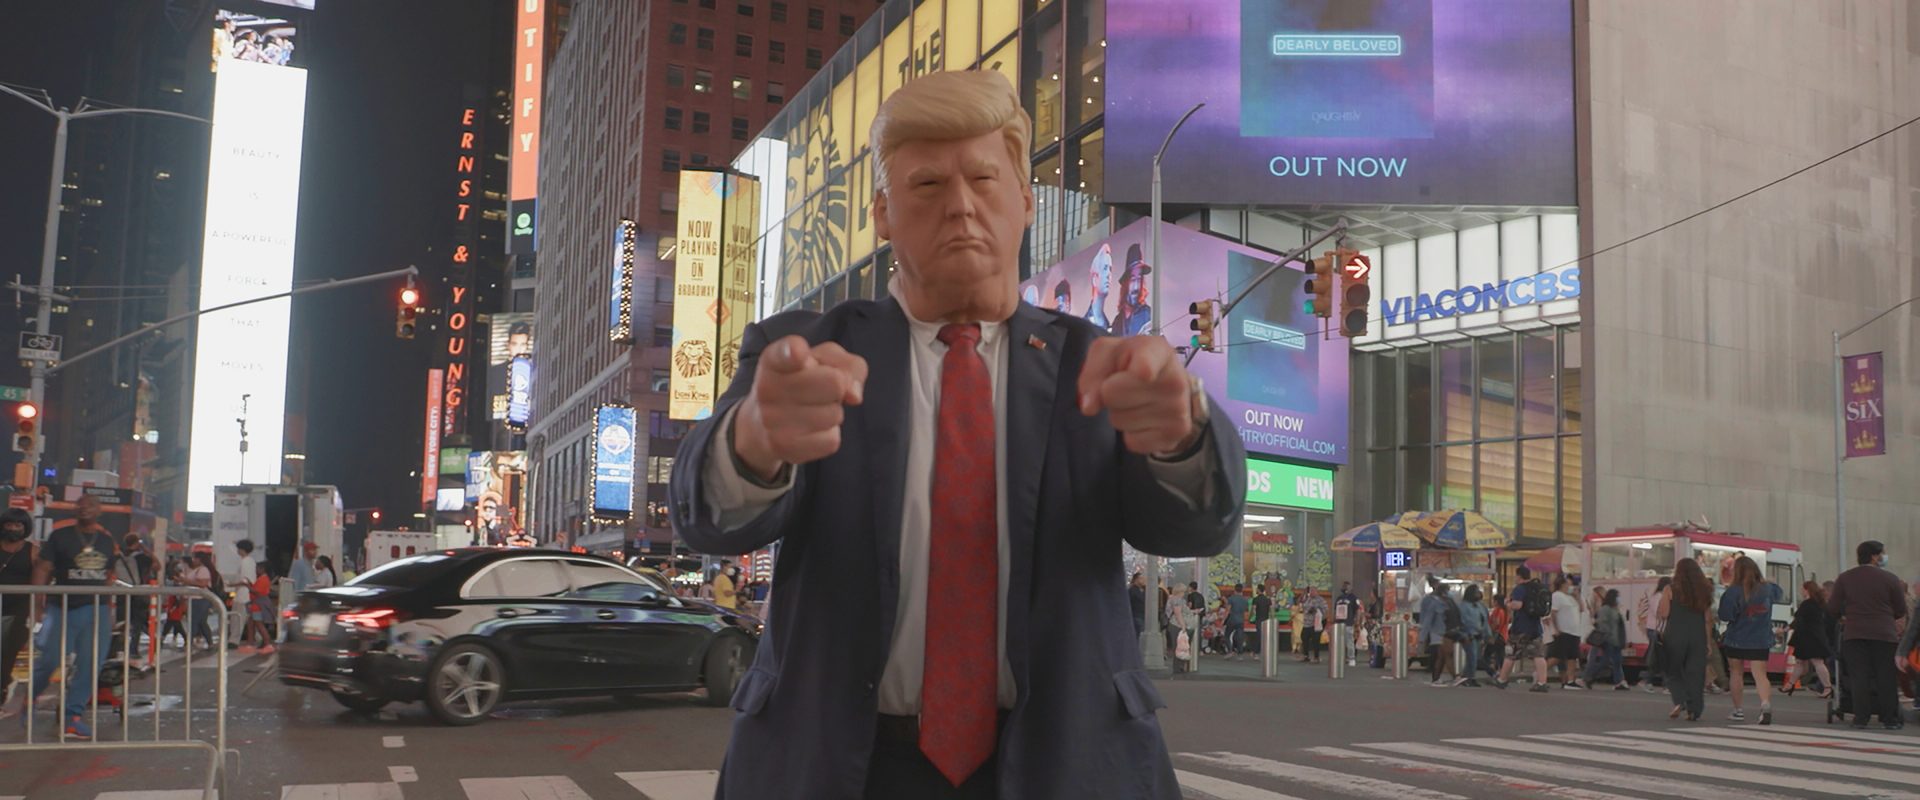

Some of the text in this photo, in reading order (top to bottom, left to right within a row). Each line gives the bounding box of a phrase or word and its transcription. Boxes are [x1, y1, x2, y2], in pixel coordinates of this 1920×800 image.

[1277, 39, 1398, 51] DEARLY BELOVED
[898, 28, 941, 88] THE
[232, 147, 280, 159] BEAUTY
[457, 108, 475, 221] ERNST
[1269, 156, 1407, 177] OUT NOW
[687, 220, 713, 238] NOW
[453, 245, 468, 263] &
[680, 239, 717, 256] PLAYING
[691, 261, 703, 277] ON
[678, 283, 715, 297] BROADWAY
[1380, 267, 1580, 327] VIACOMCBS
[447, 287, 467, 407] YOUNG
[1245, 409, 1304, 433] OUT NOW
[1239, 426, 1336, 455] HTRYOFFICIAL.COM
[1252, 543, 1295, 555] MINIONS
